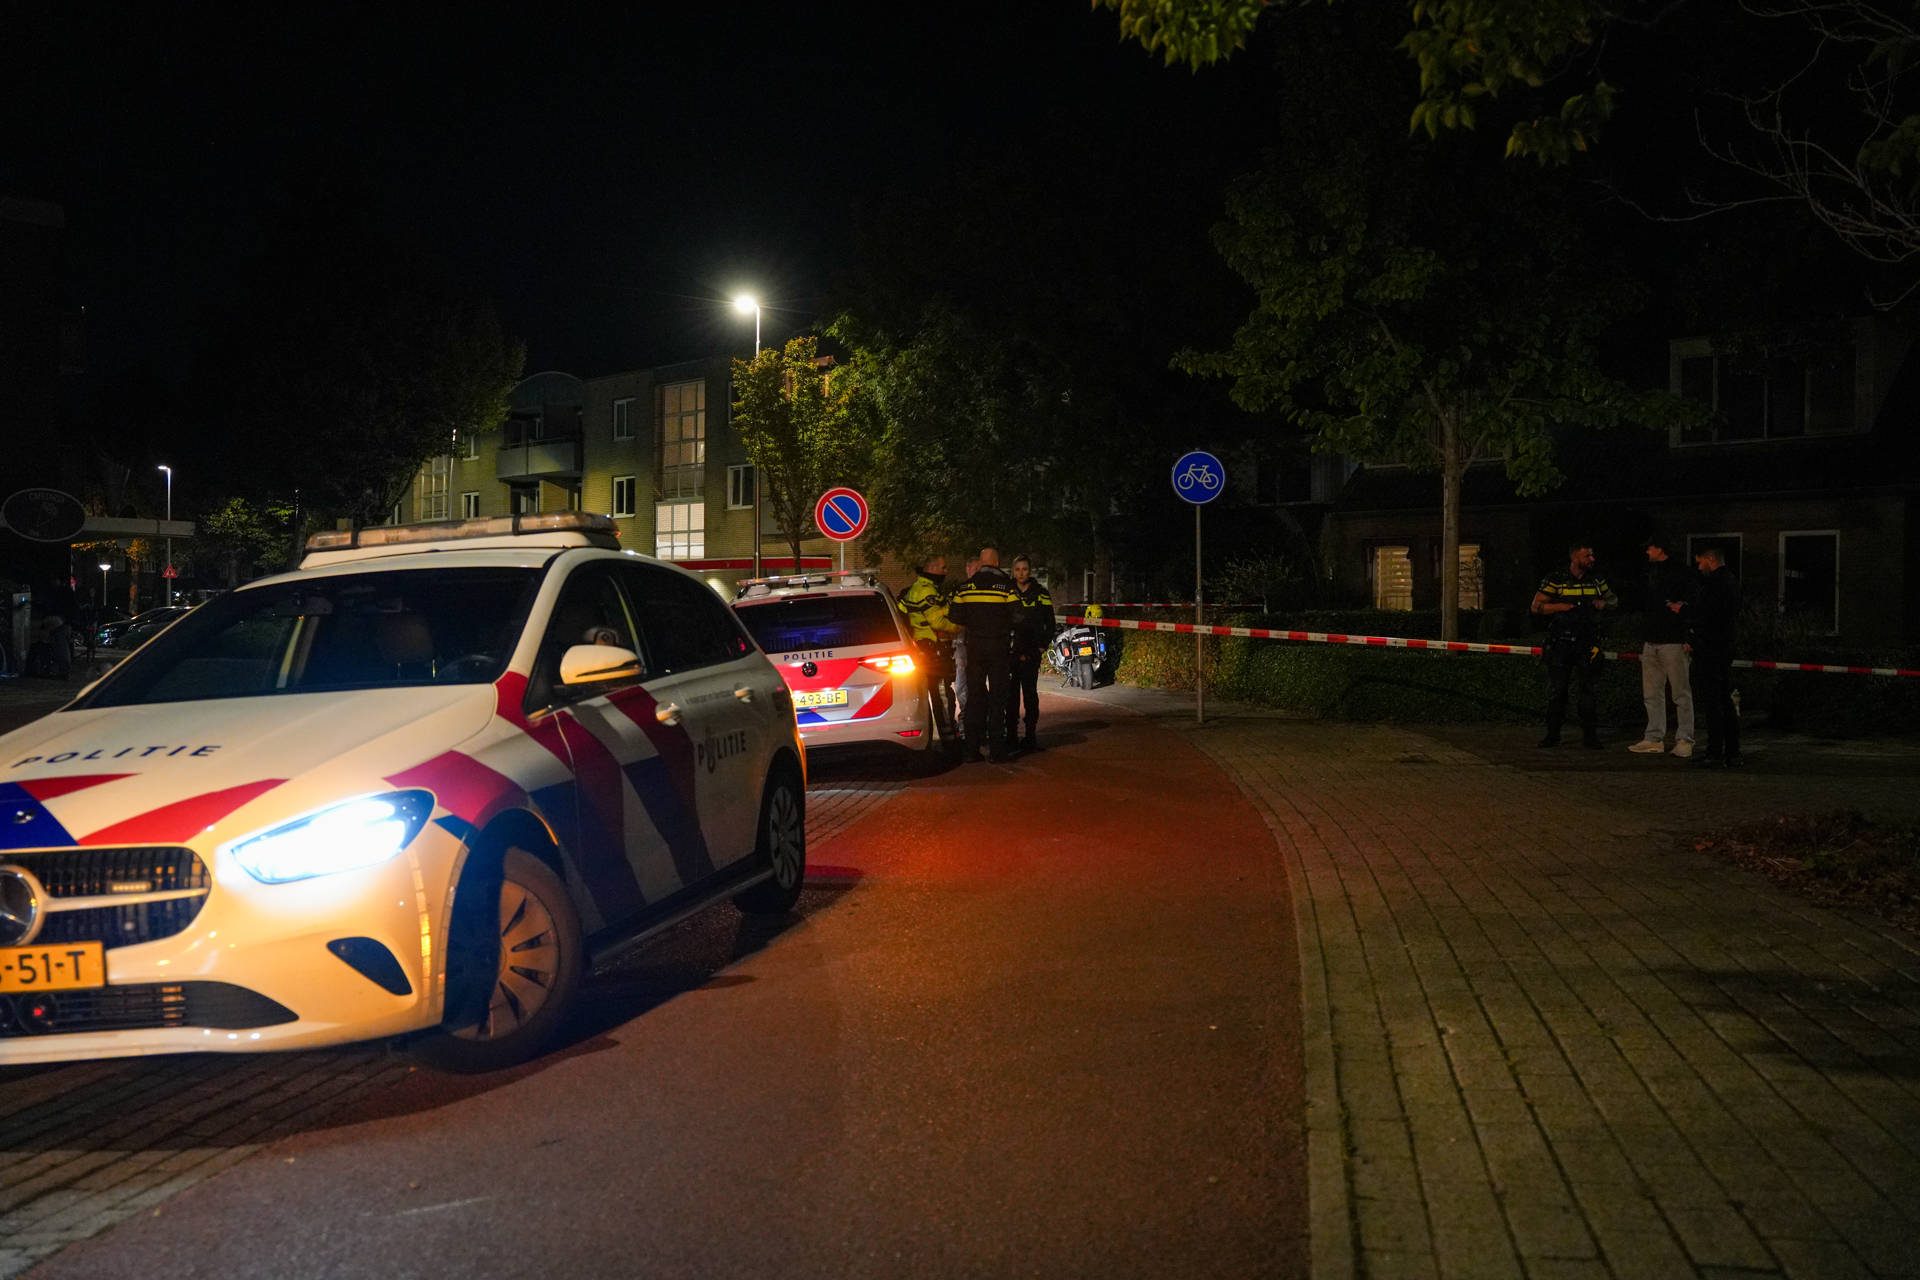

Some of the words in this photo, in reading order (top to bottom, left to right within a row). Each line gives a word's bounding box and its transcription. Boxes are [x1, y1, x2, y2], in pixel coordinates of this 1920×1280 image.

[783, 650, 833, 661] POLITIE
[796, 692, 841, 705] -493-BF
[10, 745, 222, 768] POLITIE
[698, 731, 746, 774] POLITIE
[0, 950, 85, 985] -51-T
